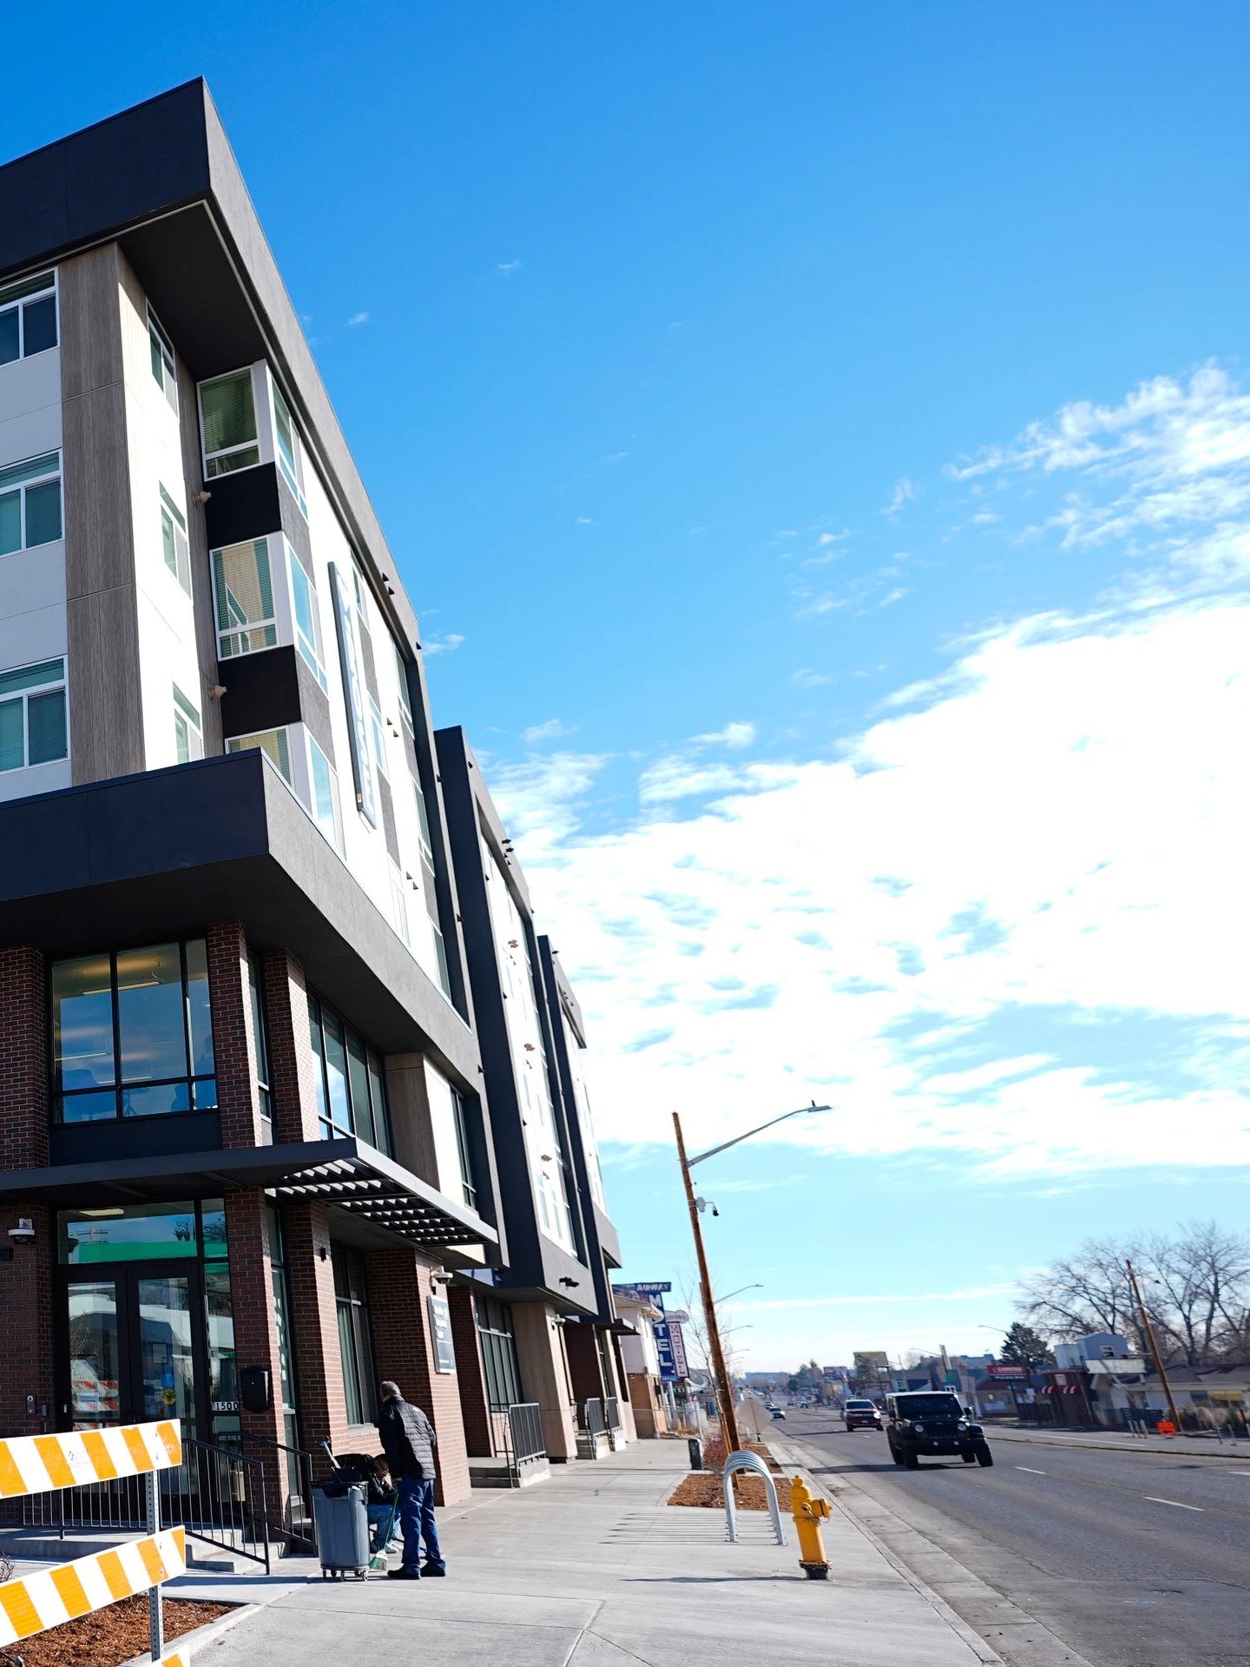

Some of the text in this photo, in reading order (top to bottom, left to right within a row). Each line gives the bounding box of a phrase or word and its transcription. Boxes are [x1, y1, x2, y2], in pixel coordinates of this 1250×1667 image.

[636, 1283, 668, 1292] AIRWAY
[649, 1294, 672, 1367] MTEL
[670, 1325, 686, 1374] MOTEL
[216, 1401, 239, 1411] 1500
